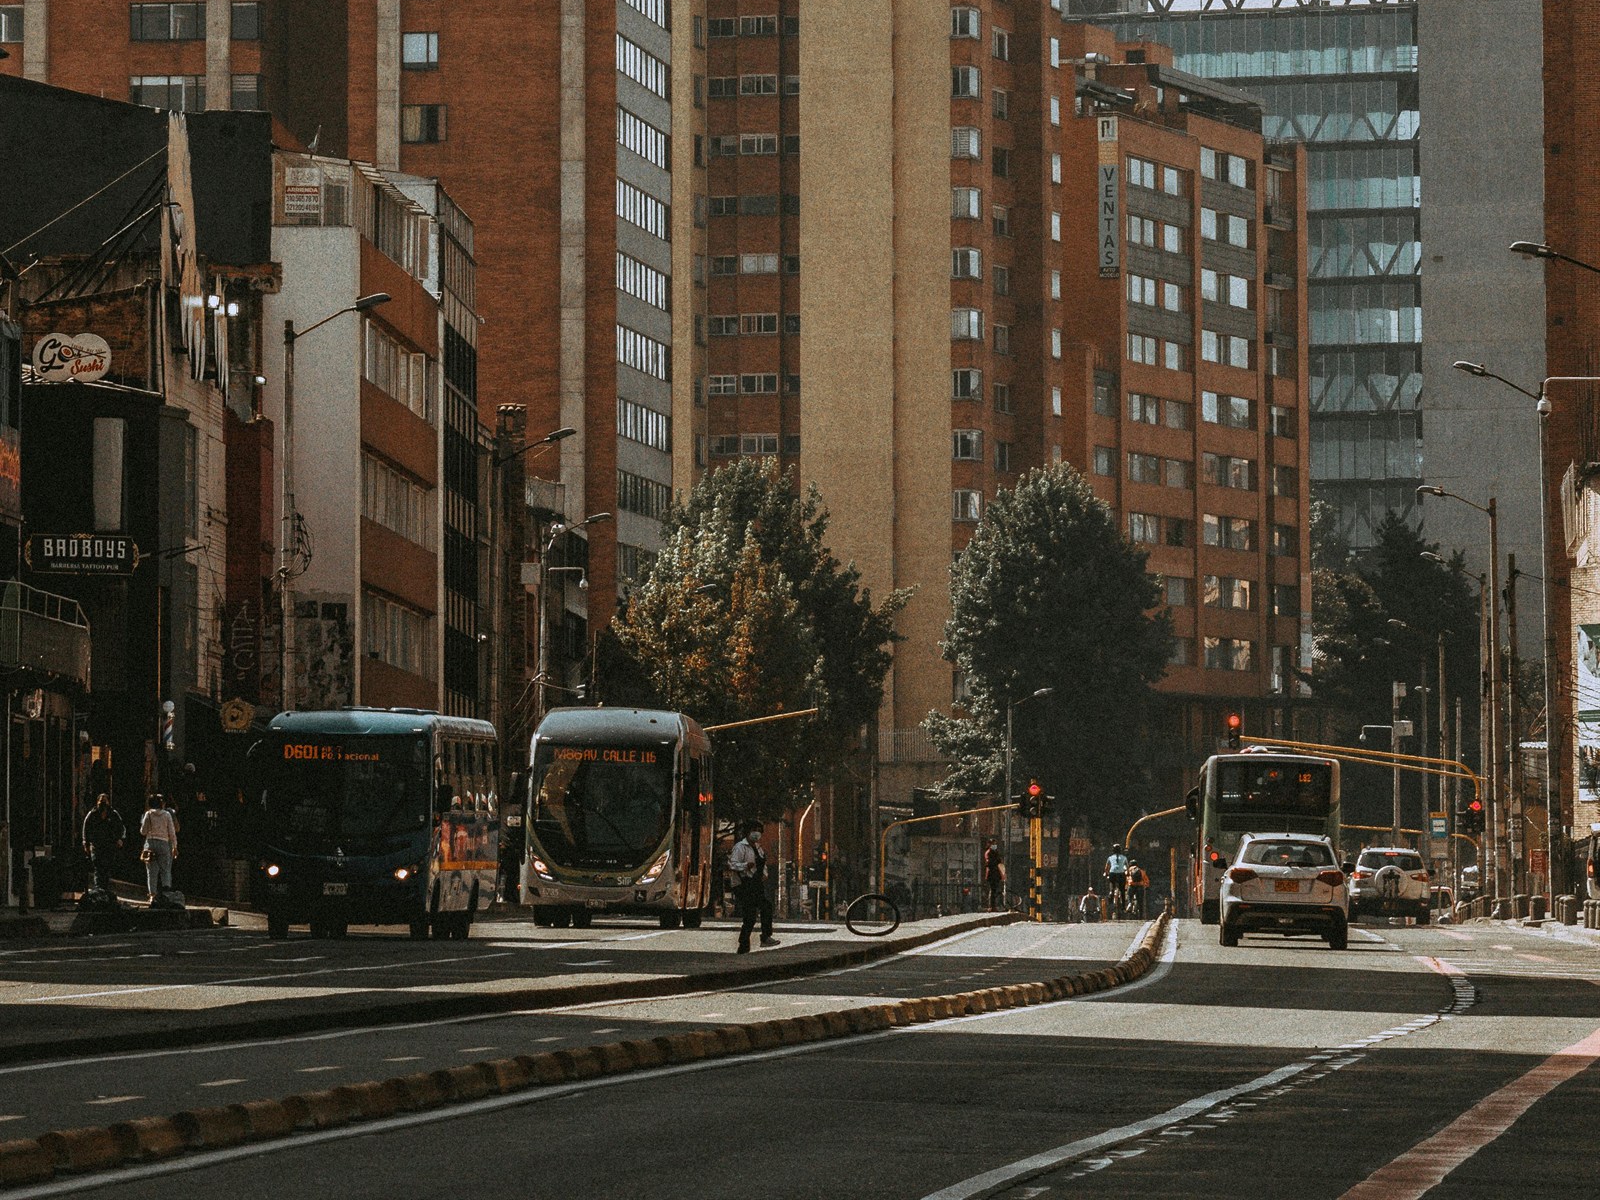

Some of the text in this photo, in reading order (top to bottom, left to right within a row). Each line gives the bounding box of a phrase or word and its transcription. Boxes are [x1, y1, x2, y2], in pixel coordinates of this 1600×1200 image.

[1103, 167, 1115, 265] VENTAS
[71, 358, 105, 375] Sushi
[283, 744, 319, 759] D601
[602, 749, 637, 763] CALLE
